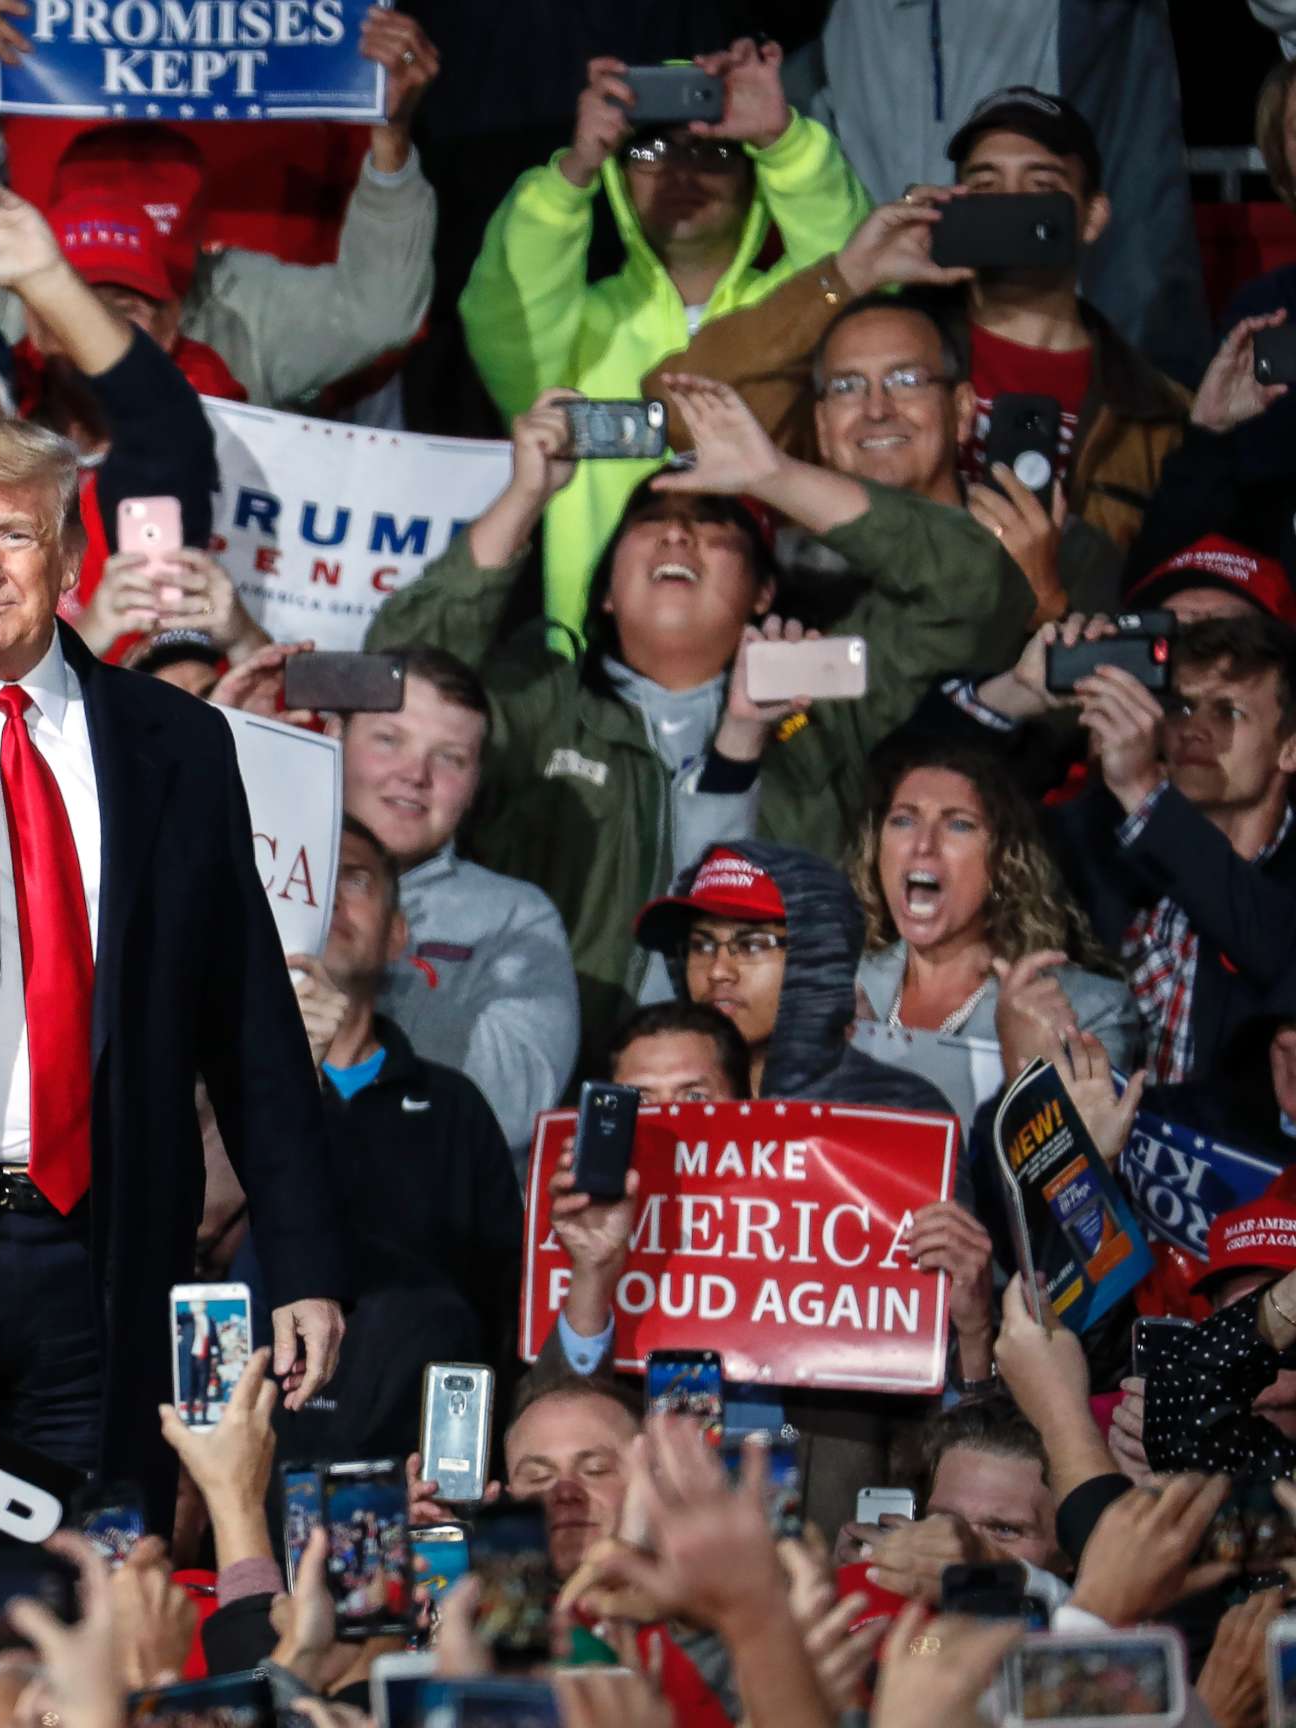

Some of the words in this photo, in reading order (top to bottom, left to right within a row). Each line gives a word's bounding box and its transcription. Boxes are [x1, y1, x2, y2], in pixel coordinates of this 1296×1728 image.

[32, 0, 345, 46] PROMISES
[102, 48, 268, 97] KEPT
[231, 485, 471, 557] RUM
[1009, 1099, 1065, 1171] NEW!
[674, 1140, 808, 1181] MAKE
[1224, 1218, 1256, 1239] MAKE
[1226, 1232, 1267, 1252] GREAT
[548, 1267, 738, 1321] POUD
[750, 1278, 921, 1334] AGAIN
